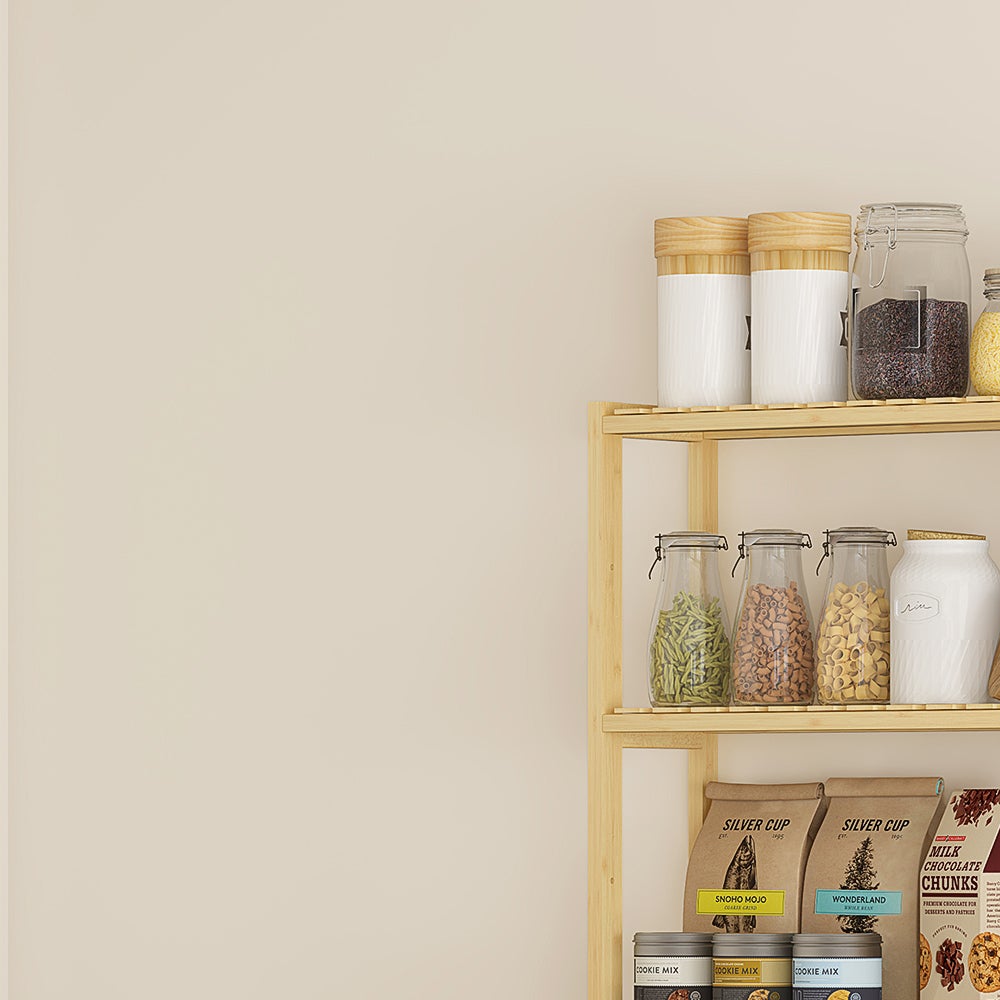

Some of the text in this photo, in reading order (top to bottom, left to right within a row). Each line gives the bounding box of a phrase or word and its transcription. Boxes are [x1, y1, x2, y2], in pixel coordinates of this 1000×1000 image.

[723, 819, 790, 831] SILVER CUP
[842, 819, 910, 831] SILVER CUP
[929, 846, 962, 857] MILK
[924, 862, 982, 871] CHOCOLATE
[922, 876, 978, 890] CHUNKS
